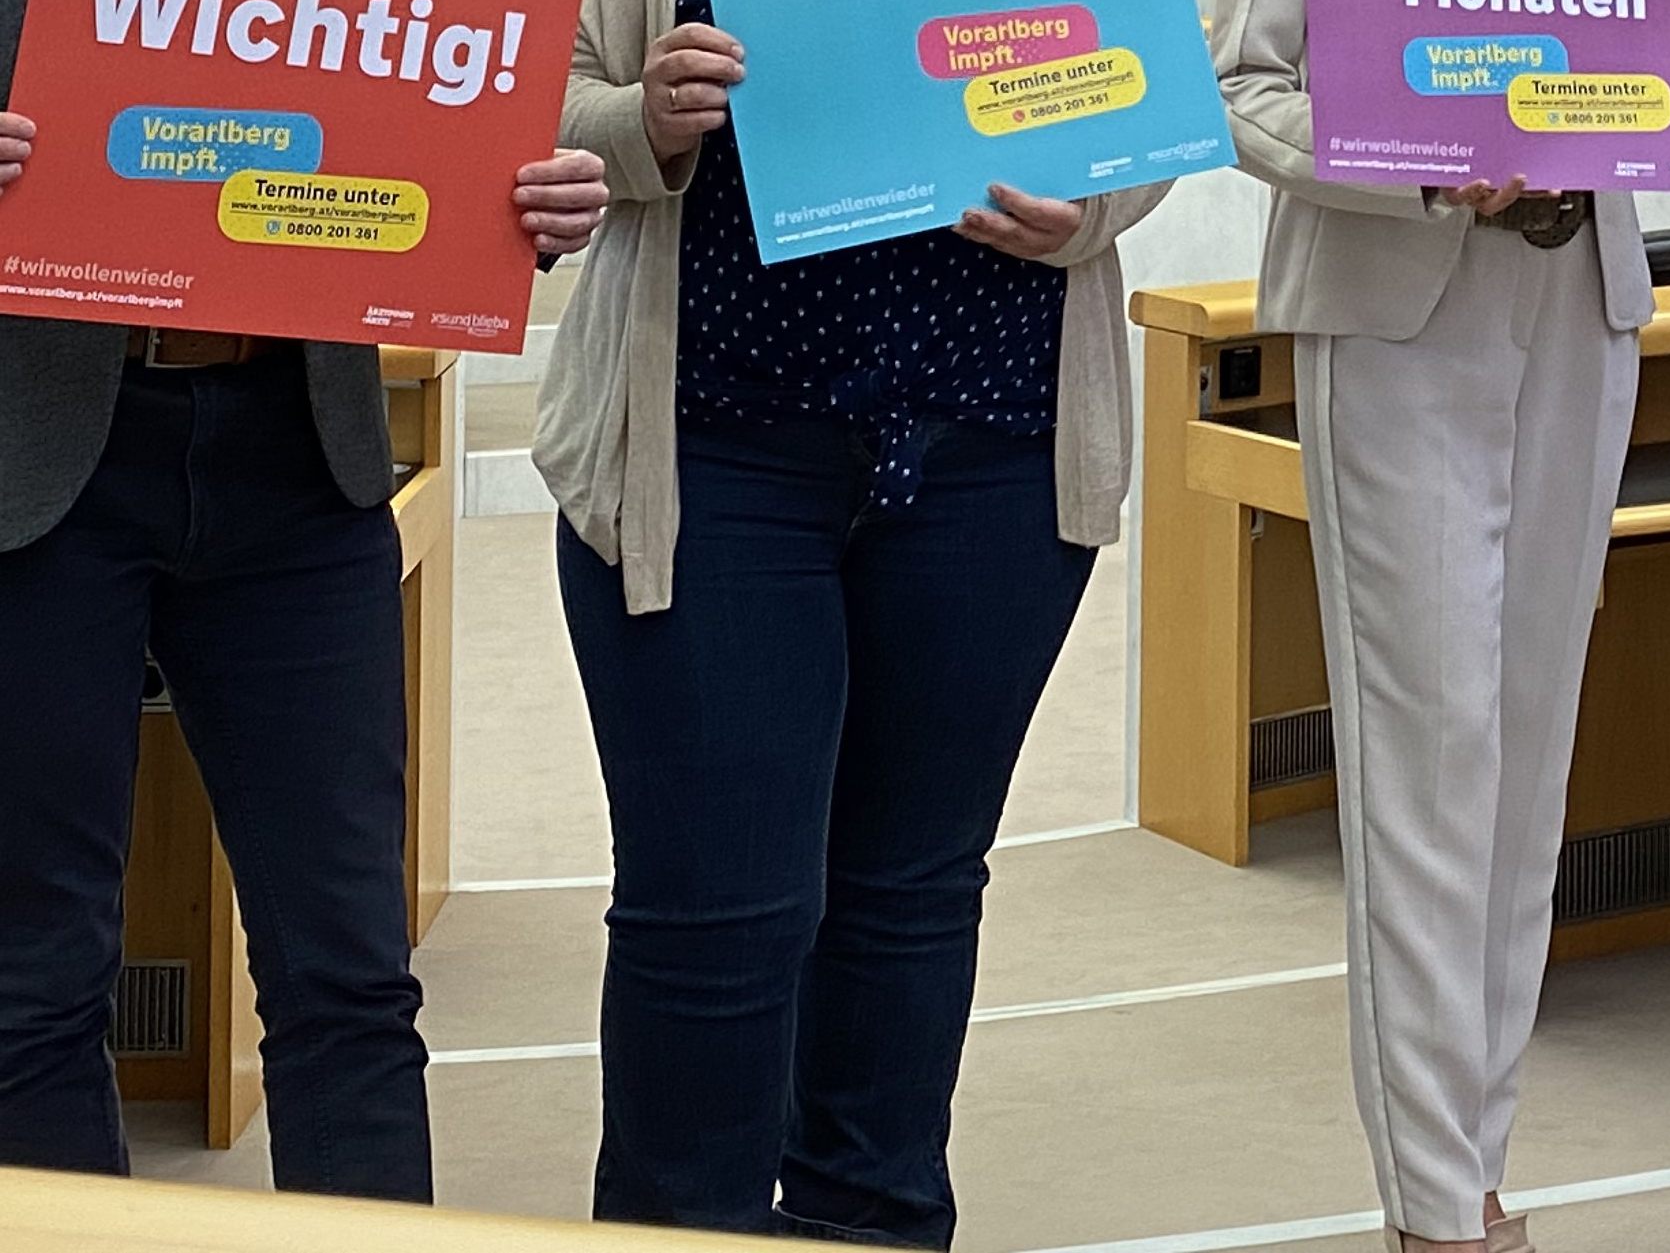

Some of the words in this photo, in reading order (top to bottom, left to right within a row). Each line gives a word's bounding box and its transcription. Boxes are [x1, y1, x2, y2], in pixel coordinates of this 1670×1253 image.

[943, 17, 1071, 48] Vorarlberg
[948, 45, 1023, 72] impft.
[1425, 43, 1543, 69] Vorarlberg
[988, 71, 1062, 96] Termine
[1066, 59, 1114, 80] unter
[1430, 67, 1498, 92] impft.
[1531, 80, 1598, 96] Termine
[1603, 82, 1646, 96] unter
[1030, 103, 1062, 118] 0800
[1063, 97, 1086, 111] 201
[1088, 92, 1110, 107] 361
[141, 115, 292, 150] Vorarlberg
[140, 145, 228, 174] impft.
[1329, 136, 1475, 157] #wirwollenwieder
[254, 178, 338, 203] Termine
[344, 187, 401, 206] unter
[773, 183, 936, 227] #wirwollenwieder
[286, 222, 323, 236] 0800
[326, 225, 351, 238] 201
[4, 255, 195, 290] #wirwollenwieder
